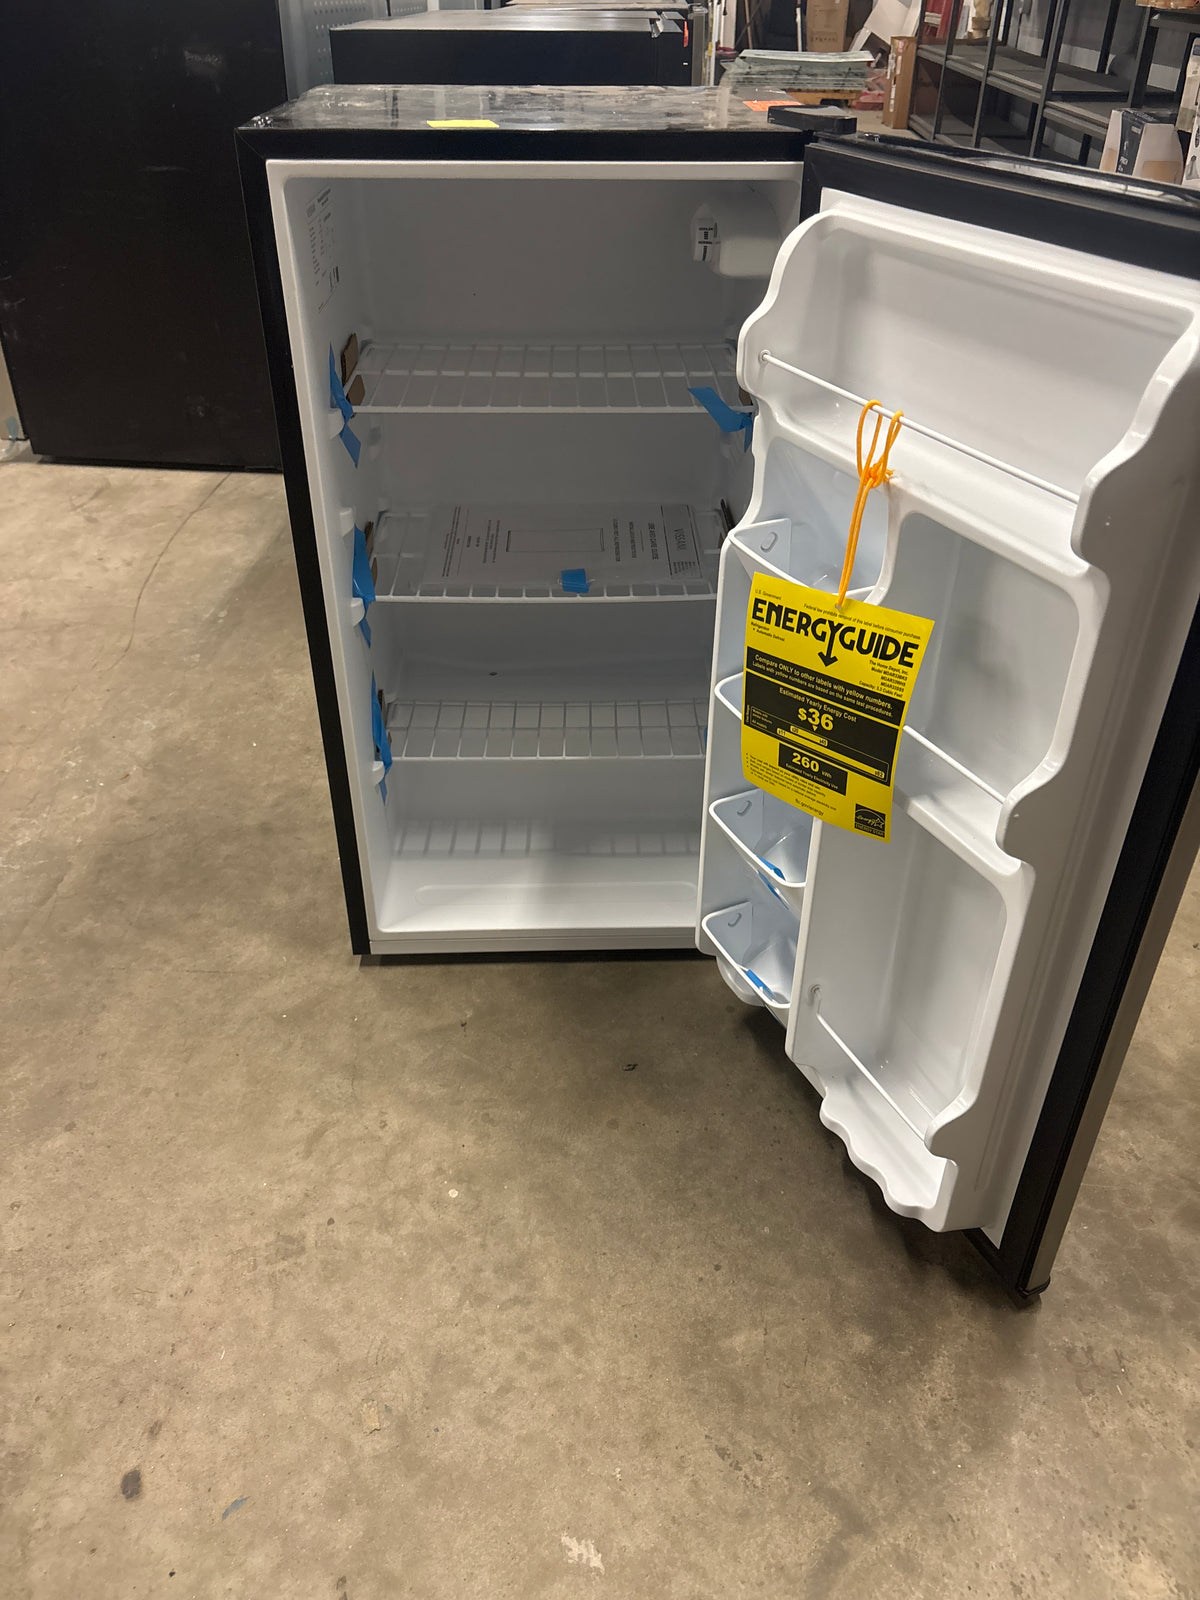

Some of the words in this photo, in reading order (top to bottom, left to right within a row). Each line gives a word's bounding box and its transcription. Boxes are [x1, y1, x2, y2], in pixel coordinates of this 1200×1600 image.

[752, 598, 919, 667] ENERGYGUIDE
[752, 660, 766, 670] Labels
[775, 671, 788, 679] yellow
[789, 675, 807, 686] numbers
[815, 685, 829, 694] based
[844, 696, 856, 704] same
[856, 699, 866, 707] test
[755, 654, 778, 668] Compare
[779, 664, 794, 673] ONLY
[800, 672, 816, 682] other
[815, 677, 832, 688] labels
[833, 684, 845, 693] with
[846, 688, 864, 699] yellow
[865, 695, 893, 710] numbers.
[779, 687, 805, 702] Estimated
[806, 696, 823, 711] Yearly
[823, 701, 843, 718] Energy
[843, 711, 857, 723] Cost
[797, 707, 834, 731] $36
[792, 752, 819, 772] 260
